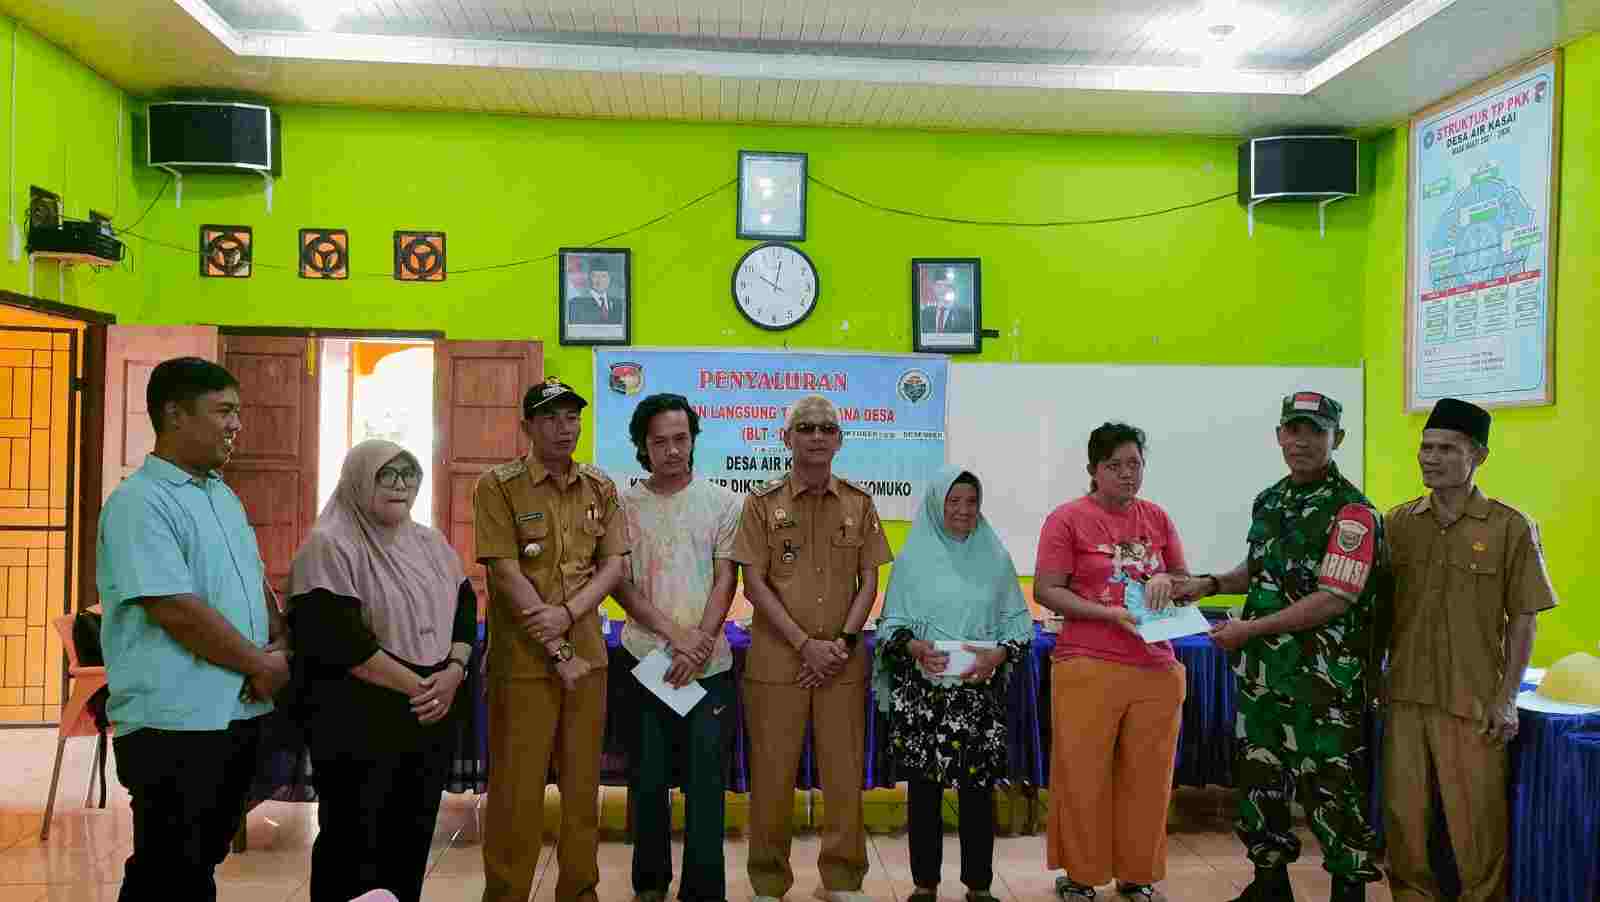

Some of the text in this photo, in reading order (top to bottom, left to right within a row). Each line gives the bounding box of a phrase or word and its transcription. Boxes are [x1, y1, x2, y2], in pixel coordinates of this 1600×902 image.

[1447, 132, 1468, 148] DESA
[1471, 124, 1486, 138] AIR
[1488, 112, 1517, 131] KASAI
[699, 368, 848, 391] PENYALURAN
[711, 405, 777, 420] LANGSUNG
[864, 409, 896, 423] DESA
[726, 455, 757, 471] DESA
[761, 456, 782, 471] AIR
